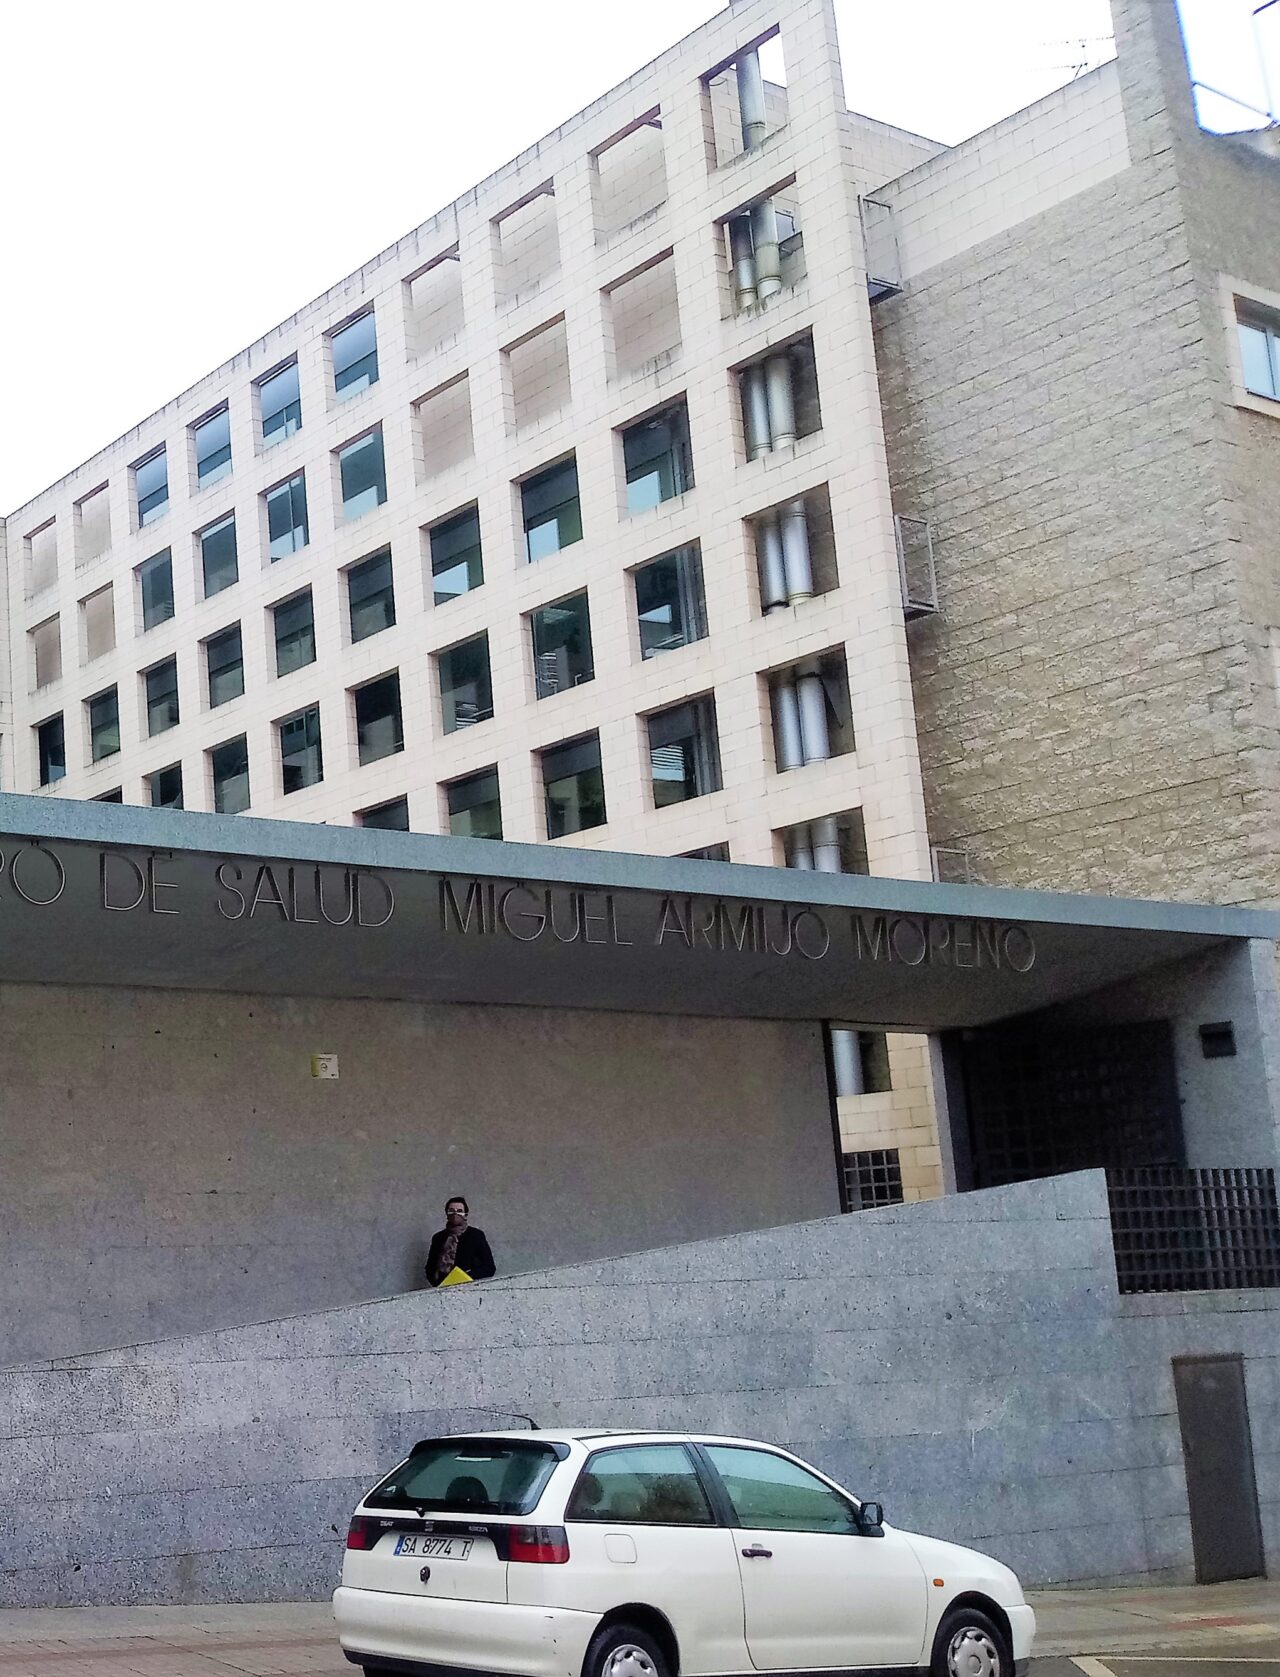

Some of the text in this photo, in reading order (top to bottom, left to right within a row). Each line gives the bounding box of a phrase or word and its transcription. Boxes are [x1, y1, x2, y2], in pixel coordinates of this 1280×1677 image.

[100, 851, 180, 914] DE
[217, 863, 395, 927] SALUD
[439, 878, 633, 942] MIGUEL
[656, 895, 830, 960] ARMIJO
[851, 914, 1036, 972] MORENO
[402, 1537, 471, 1557] SA 8774 T
